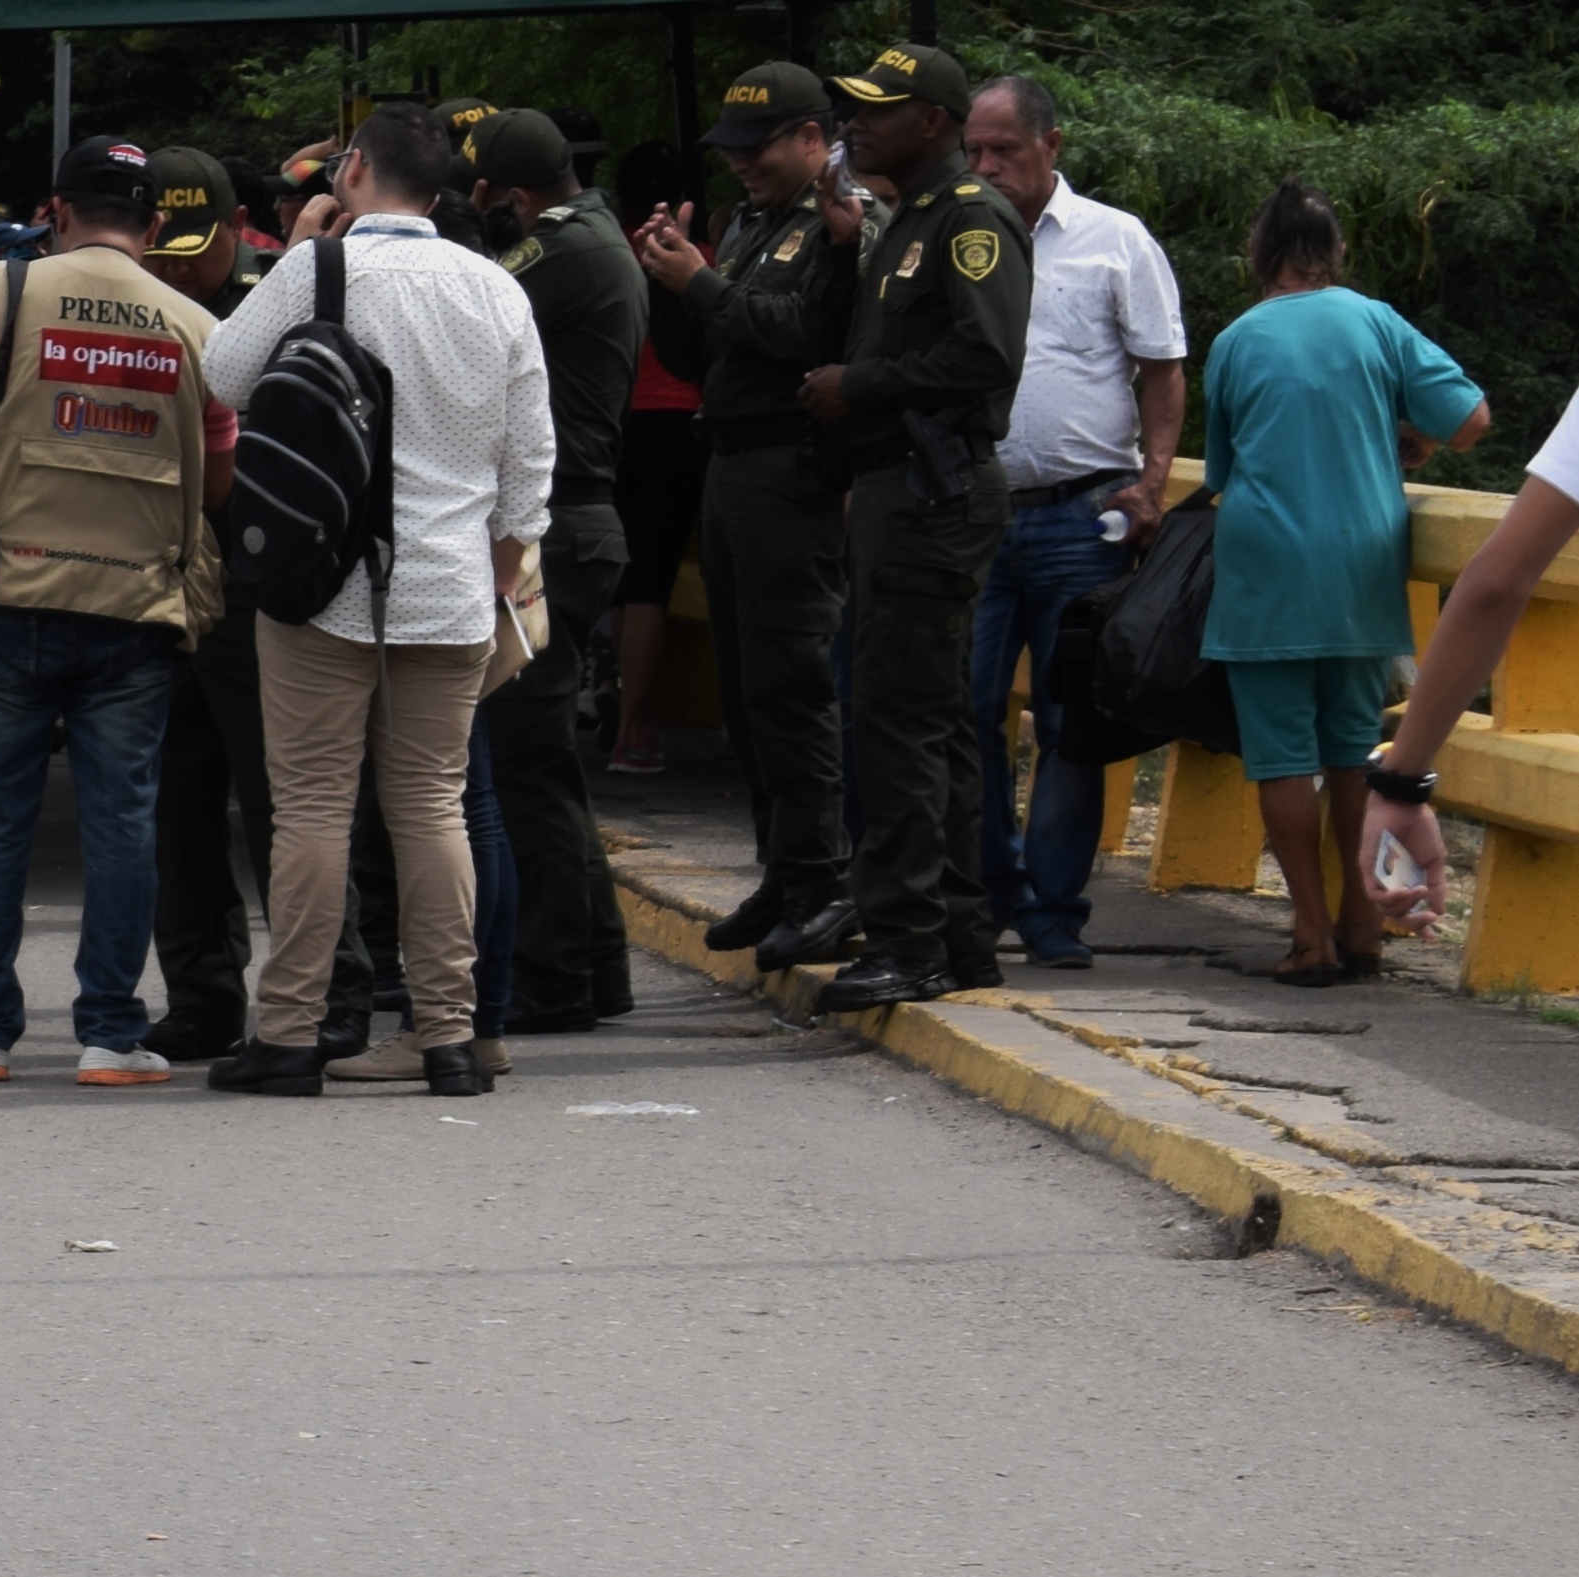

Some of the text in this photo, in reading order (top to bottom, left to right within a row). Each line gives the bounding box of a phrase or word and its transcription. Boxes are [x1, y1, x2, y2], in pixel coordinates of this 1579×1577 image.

[59, 295, 169, 331] PRENSA
[44, 339, 178, 374] la opinión
